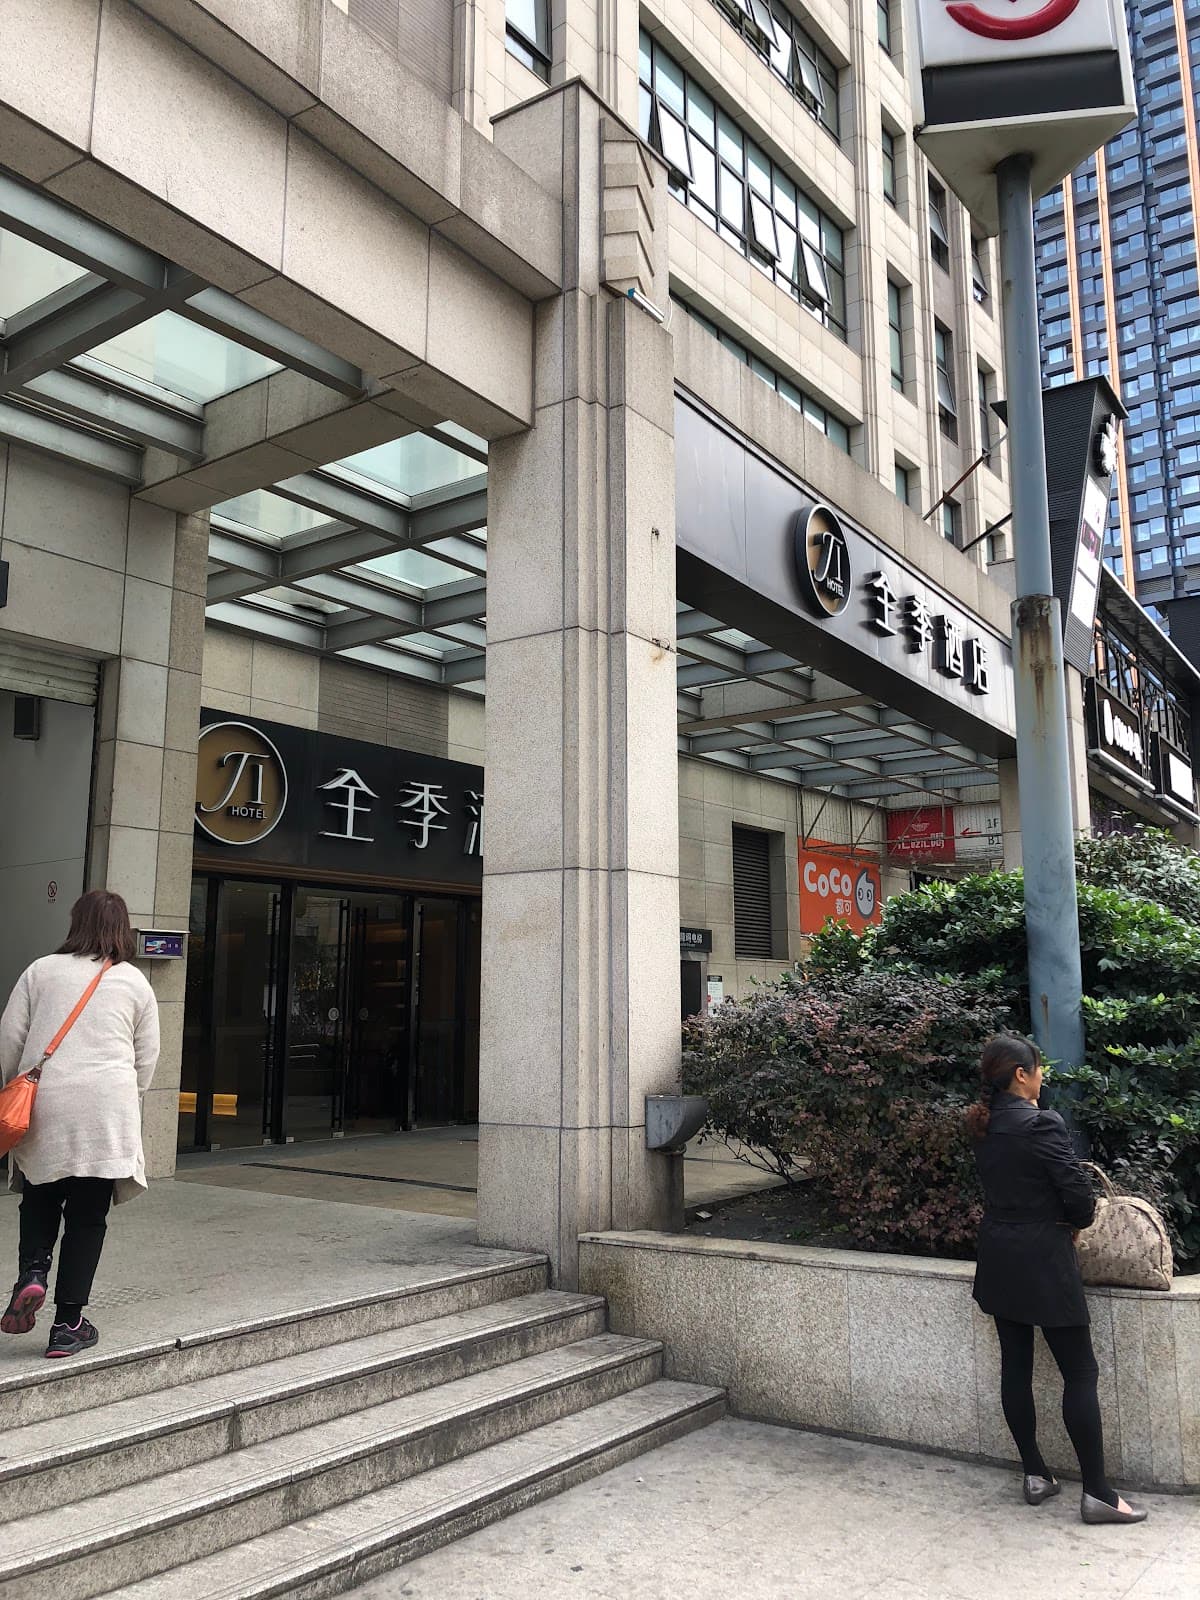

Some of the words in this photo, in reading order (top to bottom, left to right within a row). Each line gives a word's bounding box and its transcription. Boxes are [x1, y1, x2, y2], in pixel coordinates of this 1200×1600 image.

[826, 579, 844, 598] HOTEL
[867, 570, 990, 695] 全季酒店
[232, 806, 268, 820] HOTEL
[835, 898, 852, 916] 都可
